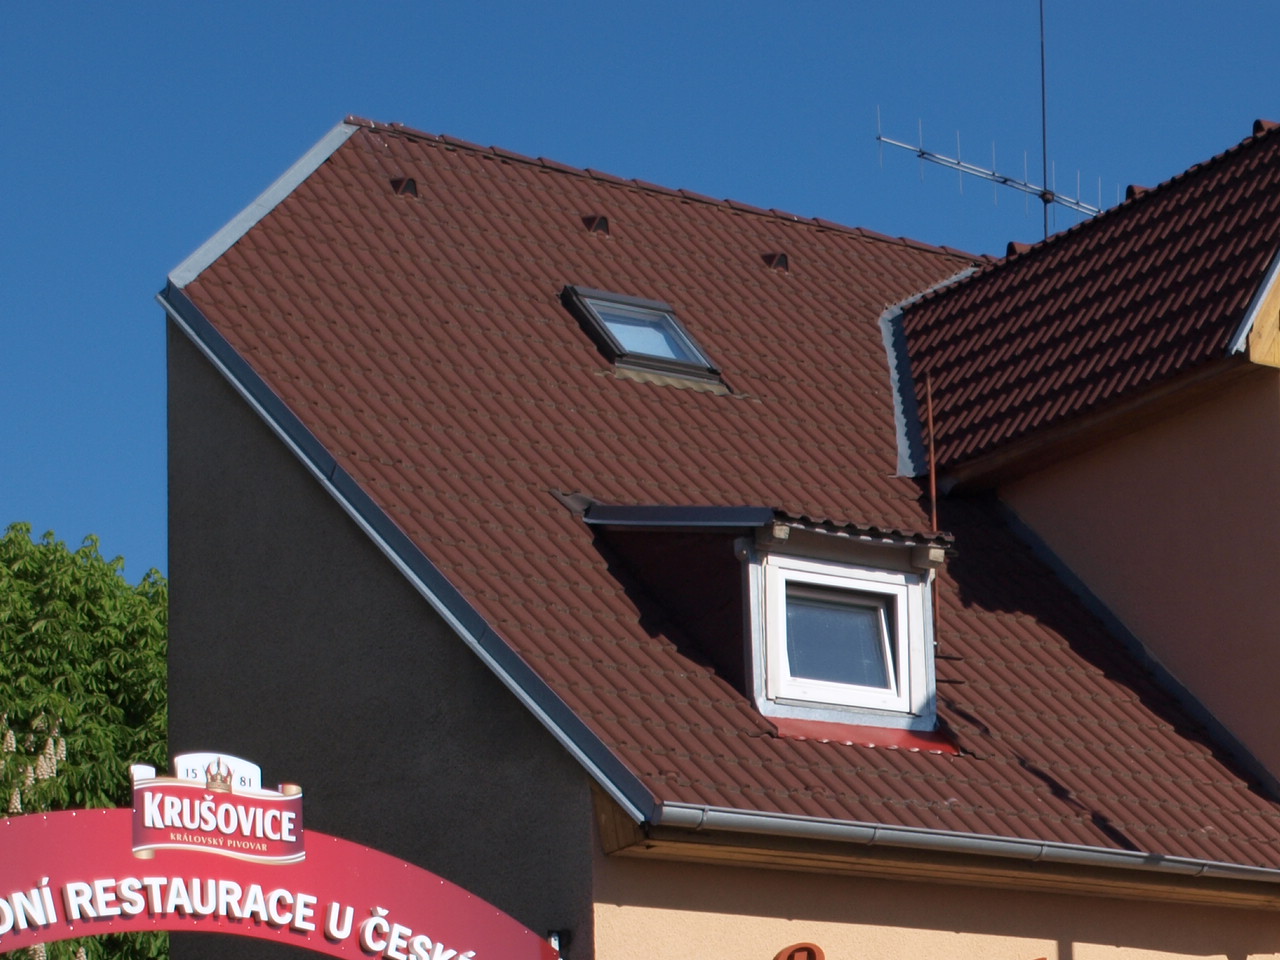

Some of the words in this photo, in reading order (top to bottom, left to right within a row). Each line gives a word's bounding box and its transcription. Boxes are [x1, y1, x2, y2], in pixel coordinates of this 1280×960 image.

[185, 768, 198, 780] 15
[239, 776, 253, 788] 81
[143, 791, 297, 843] KRUŠOVICE
[170, 832, 225, 846] KRÁLOVSKÝ
[227, 839, 268, 852] PIVOVAR
[62, 876, 318, 932] RESTAURACE
[324, 901, 355, 942] U
